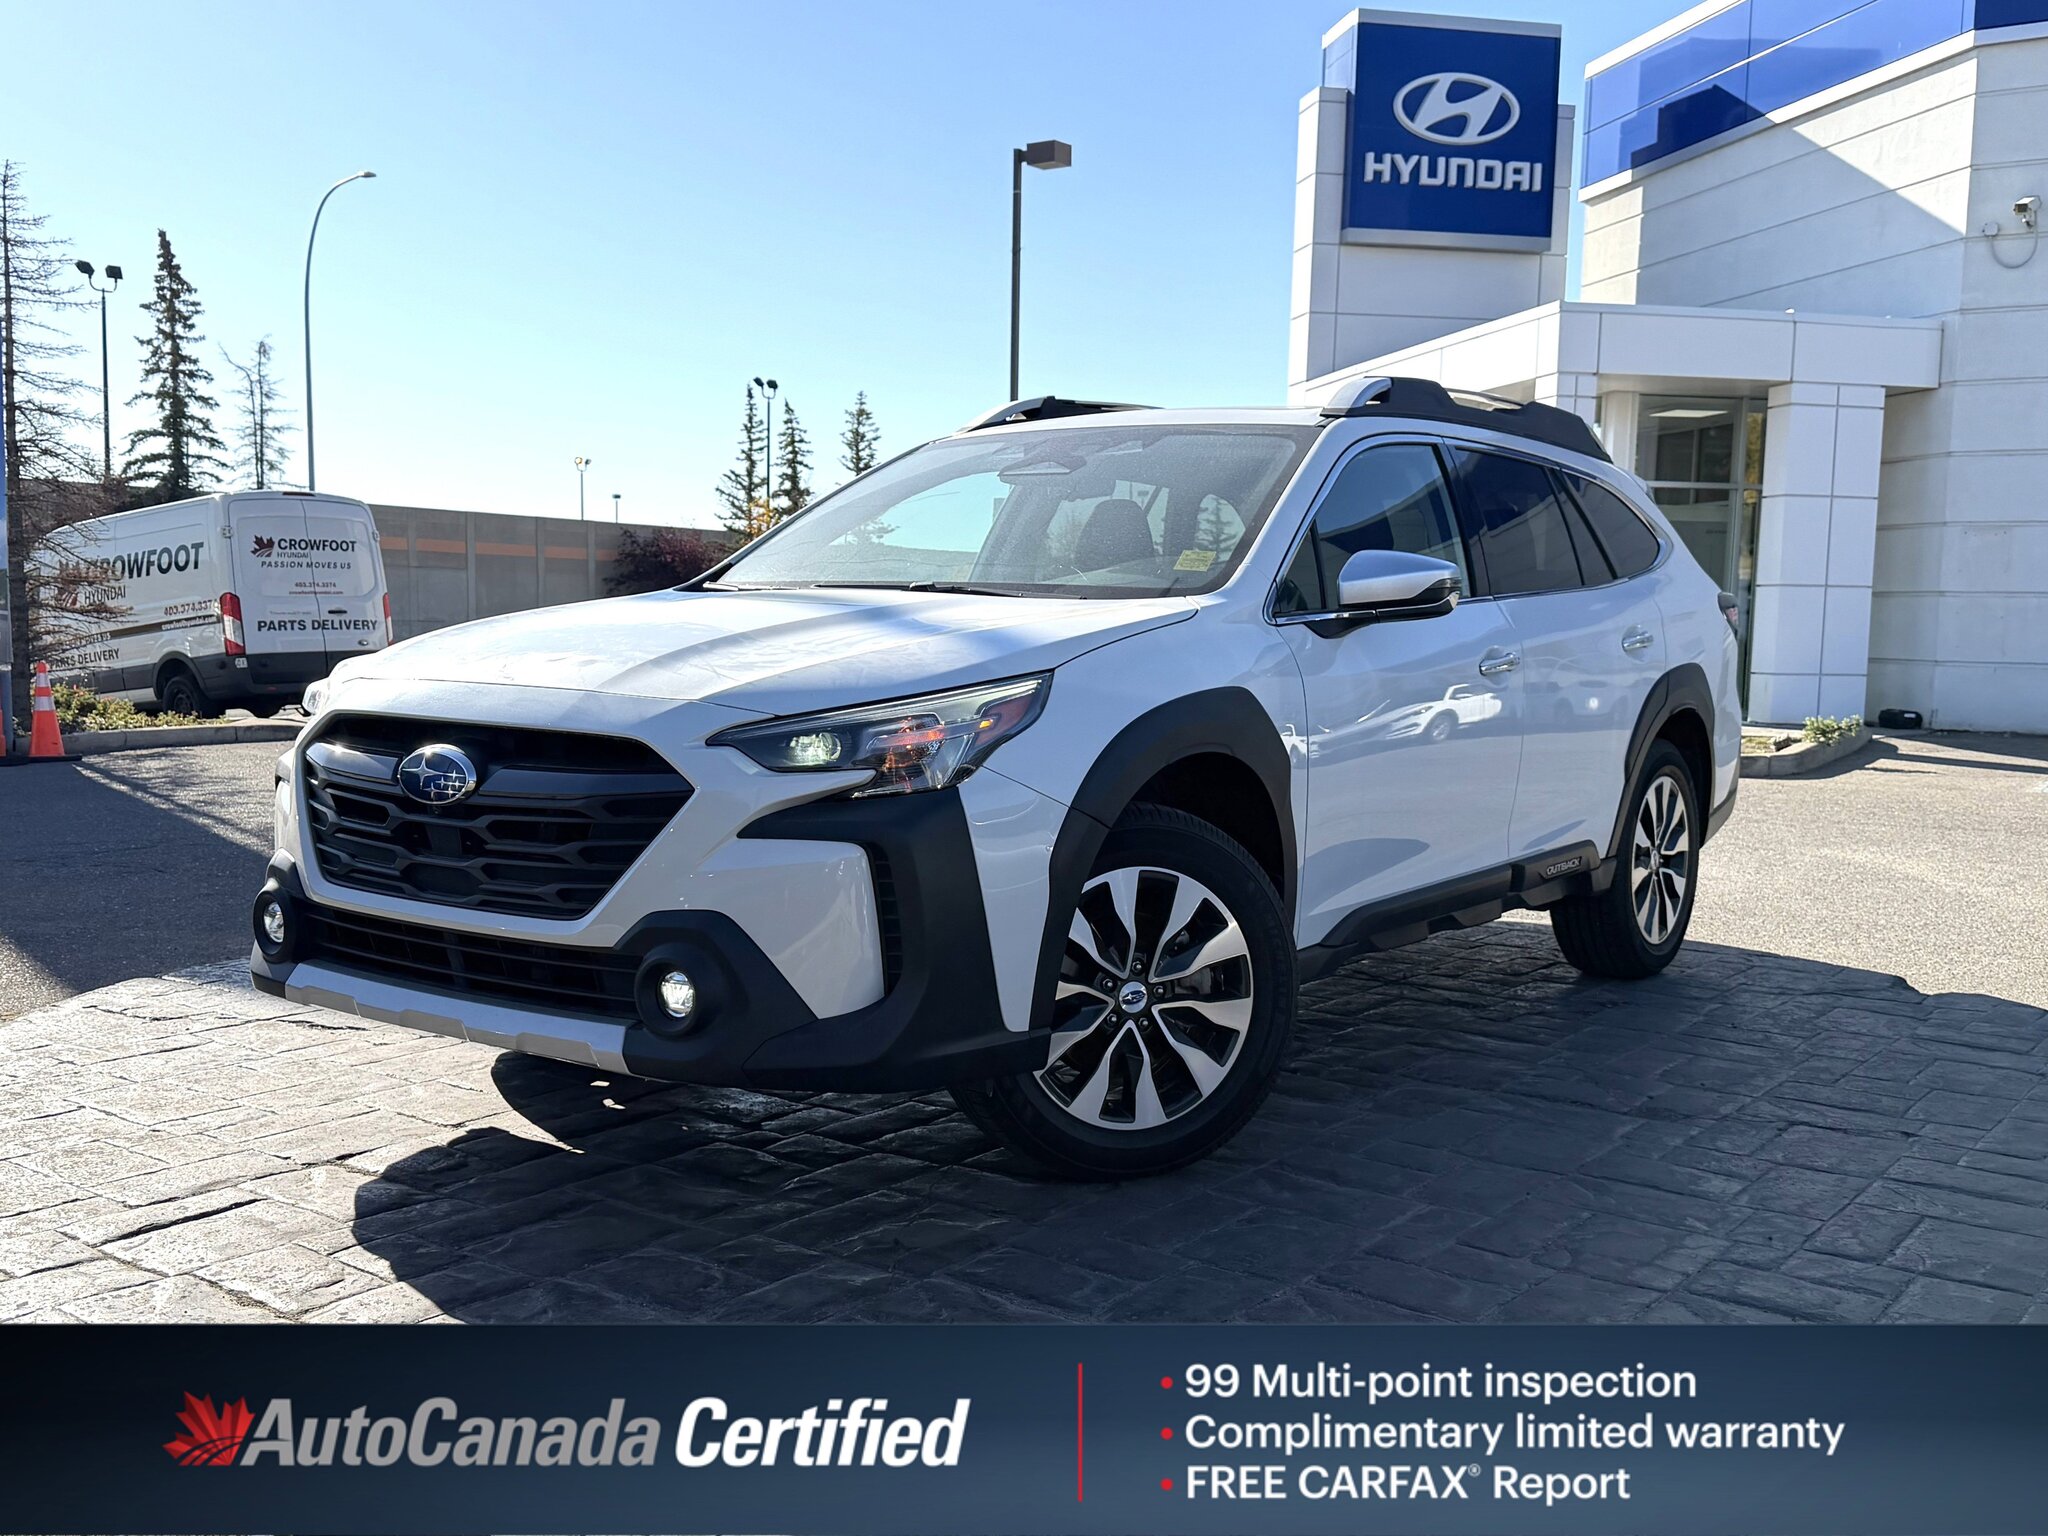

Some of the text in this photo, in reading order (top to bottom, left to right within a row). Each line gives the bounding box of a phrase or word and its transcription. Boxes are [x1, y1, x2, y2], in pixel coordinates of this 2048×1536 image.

[1363, 151, 1543, 192] HYUNDAI
[277, 538, 357, 553] CROWFOOT
[277, 551, 309, 559] HYUNDAI
[261, 560, 352, 570] PASSION MOVES US
[84, 584, 126, 605] HYUNDAI
[257, 619, 378, 632] PARTS DELIVERY
[77, 647, 120, 665] DELIVERY
[1546, 858, 1580, 875] OUTBACK
